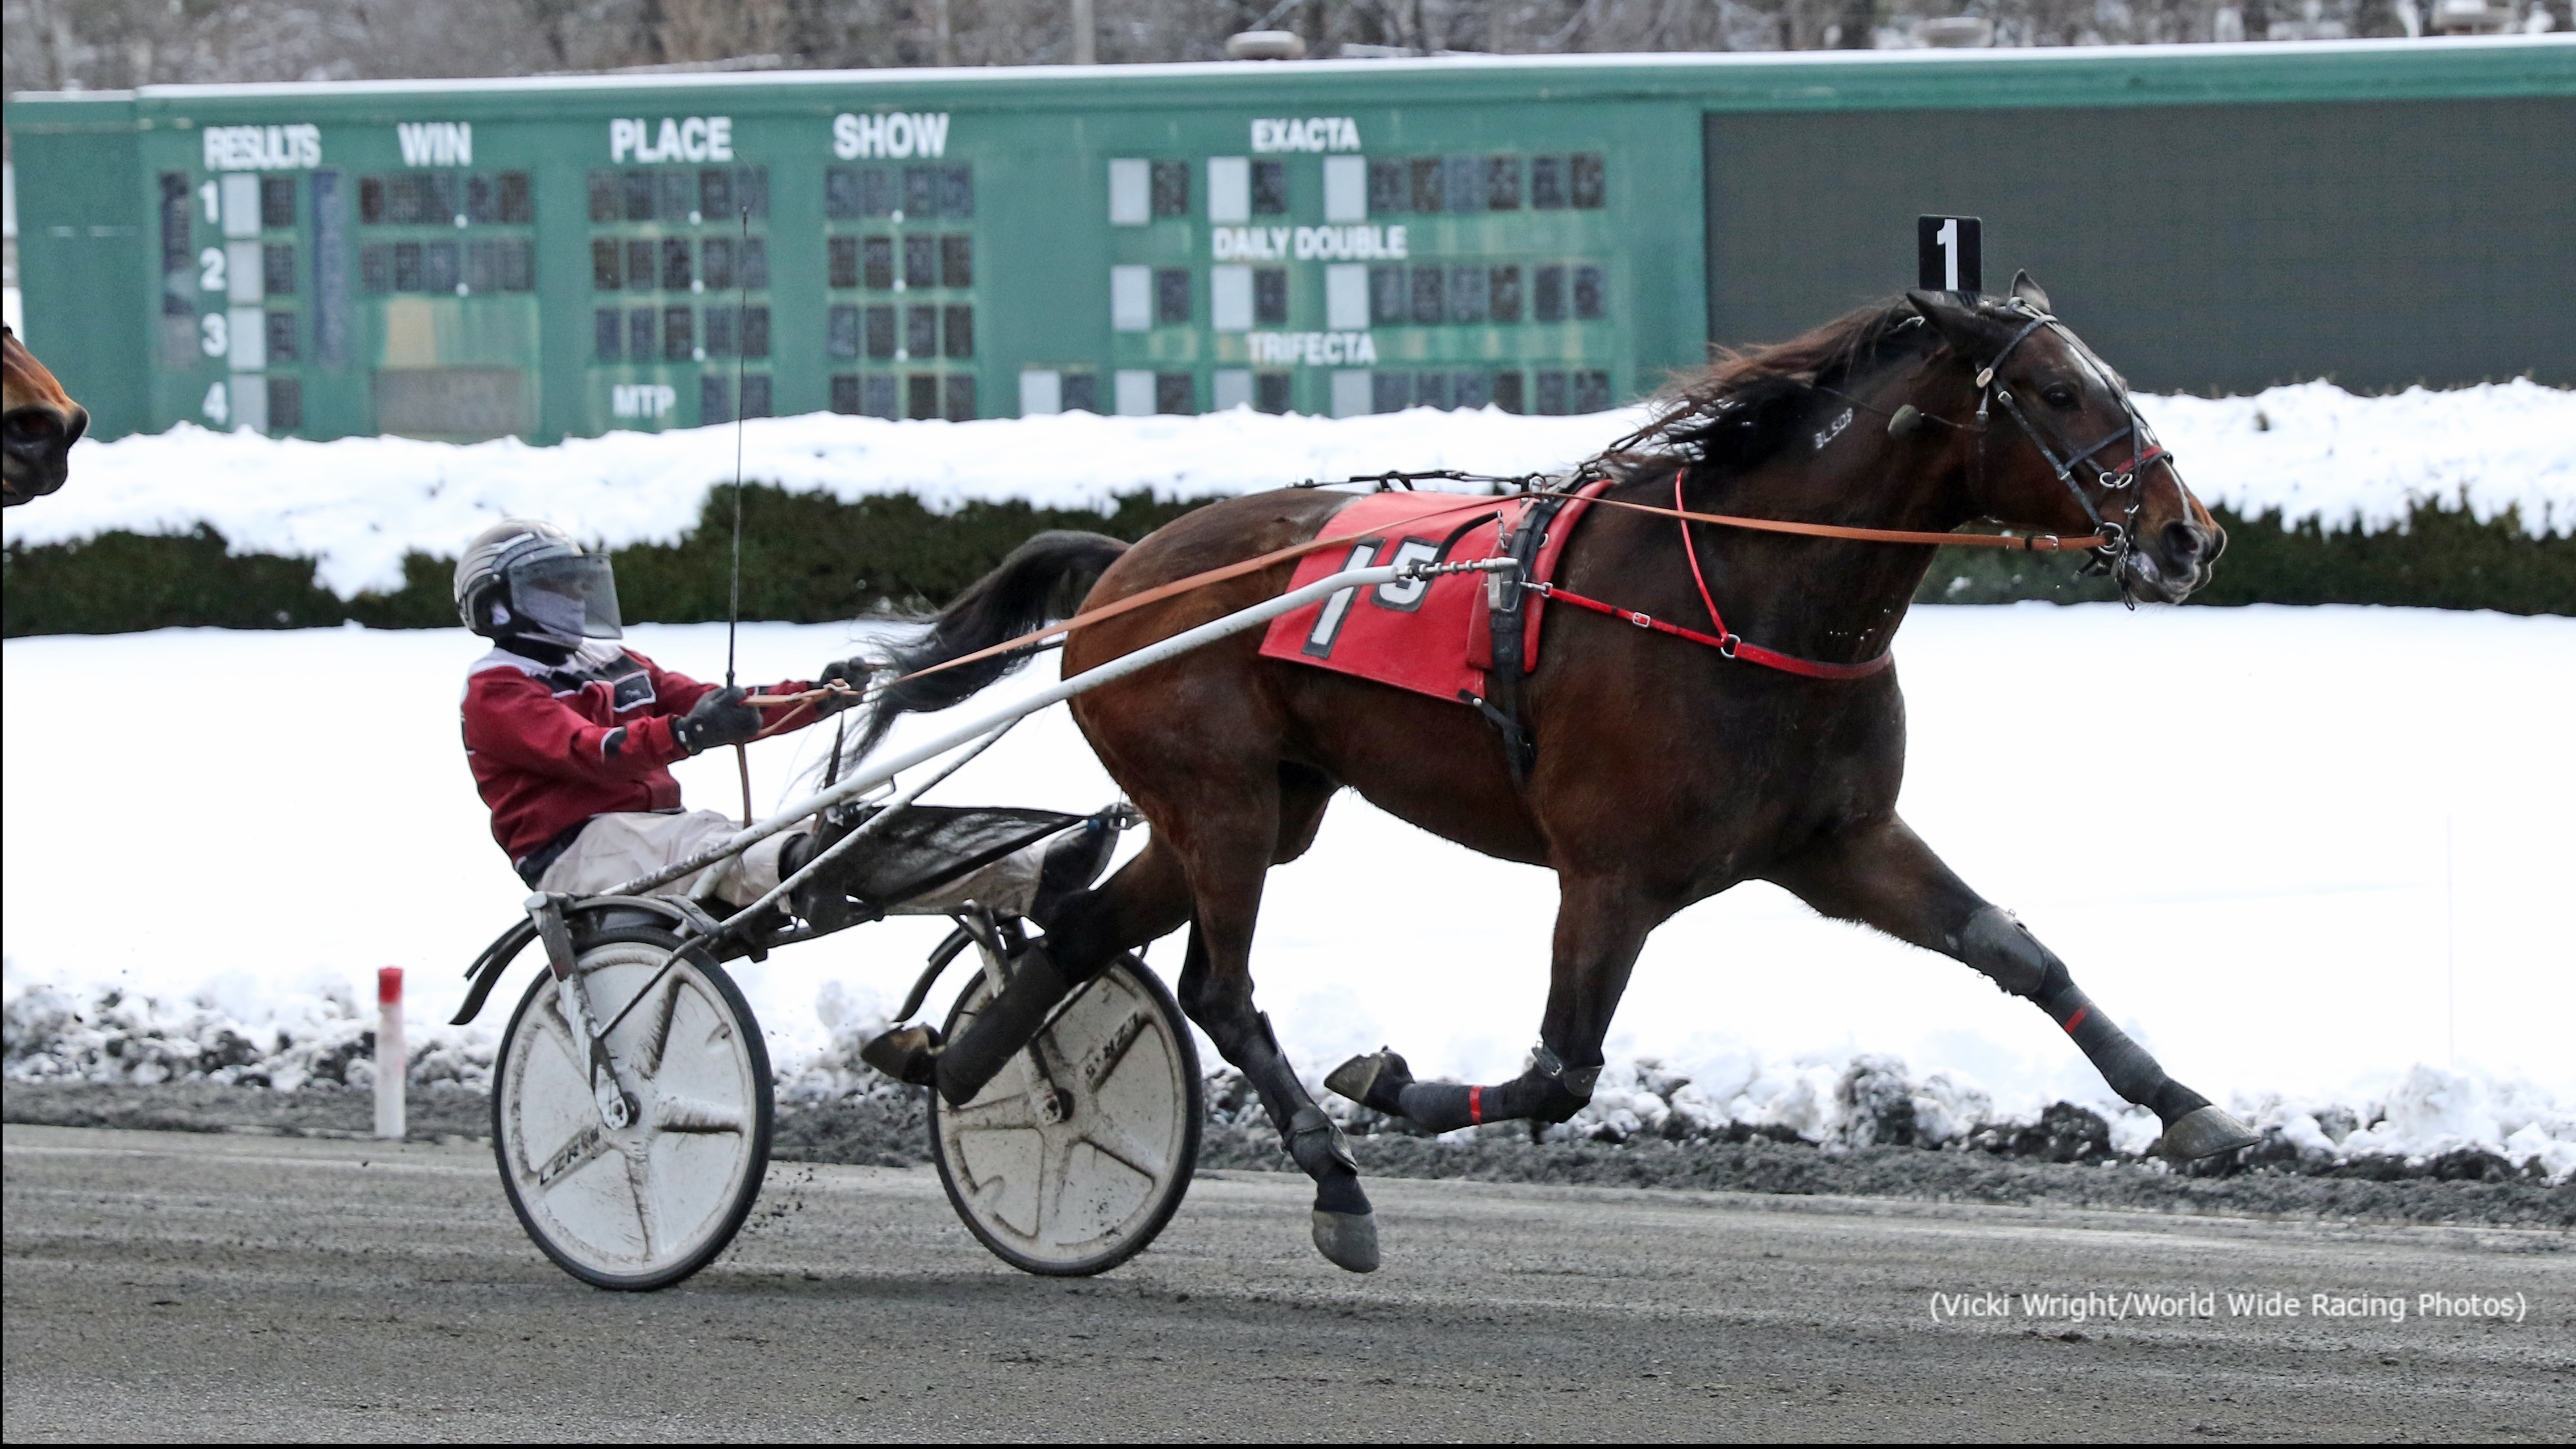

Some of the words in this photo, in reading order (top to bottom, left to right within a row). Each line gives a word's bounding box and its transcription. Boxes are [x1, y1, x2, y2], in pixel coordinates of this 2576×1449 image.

[205, 124, 321, 169] RESULTS
[398, 123, 472, 166] WIN
[611, 116, 733, 162] PLACE
[834, 112, 949, 159] SHOW
[1251, 117, 1360, 153] EXACTA
[200, 180, 218, 223] 1
[1212, 226, 1290, 260] DAILY
[1295, 226, 1408, 260] DOUBLE
[1937, 218, 1958, 291] 1
[200, 247, 226, 290] 2
[202, 313, 228, 356] 3
[1246, 332, 1377, 365] TRIFECTA
[203, 382, 228, 424] 4
[612, 385, 676, 417] MTP
